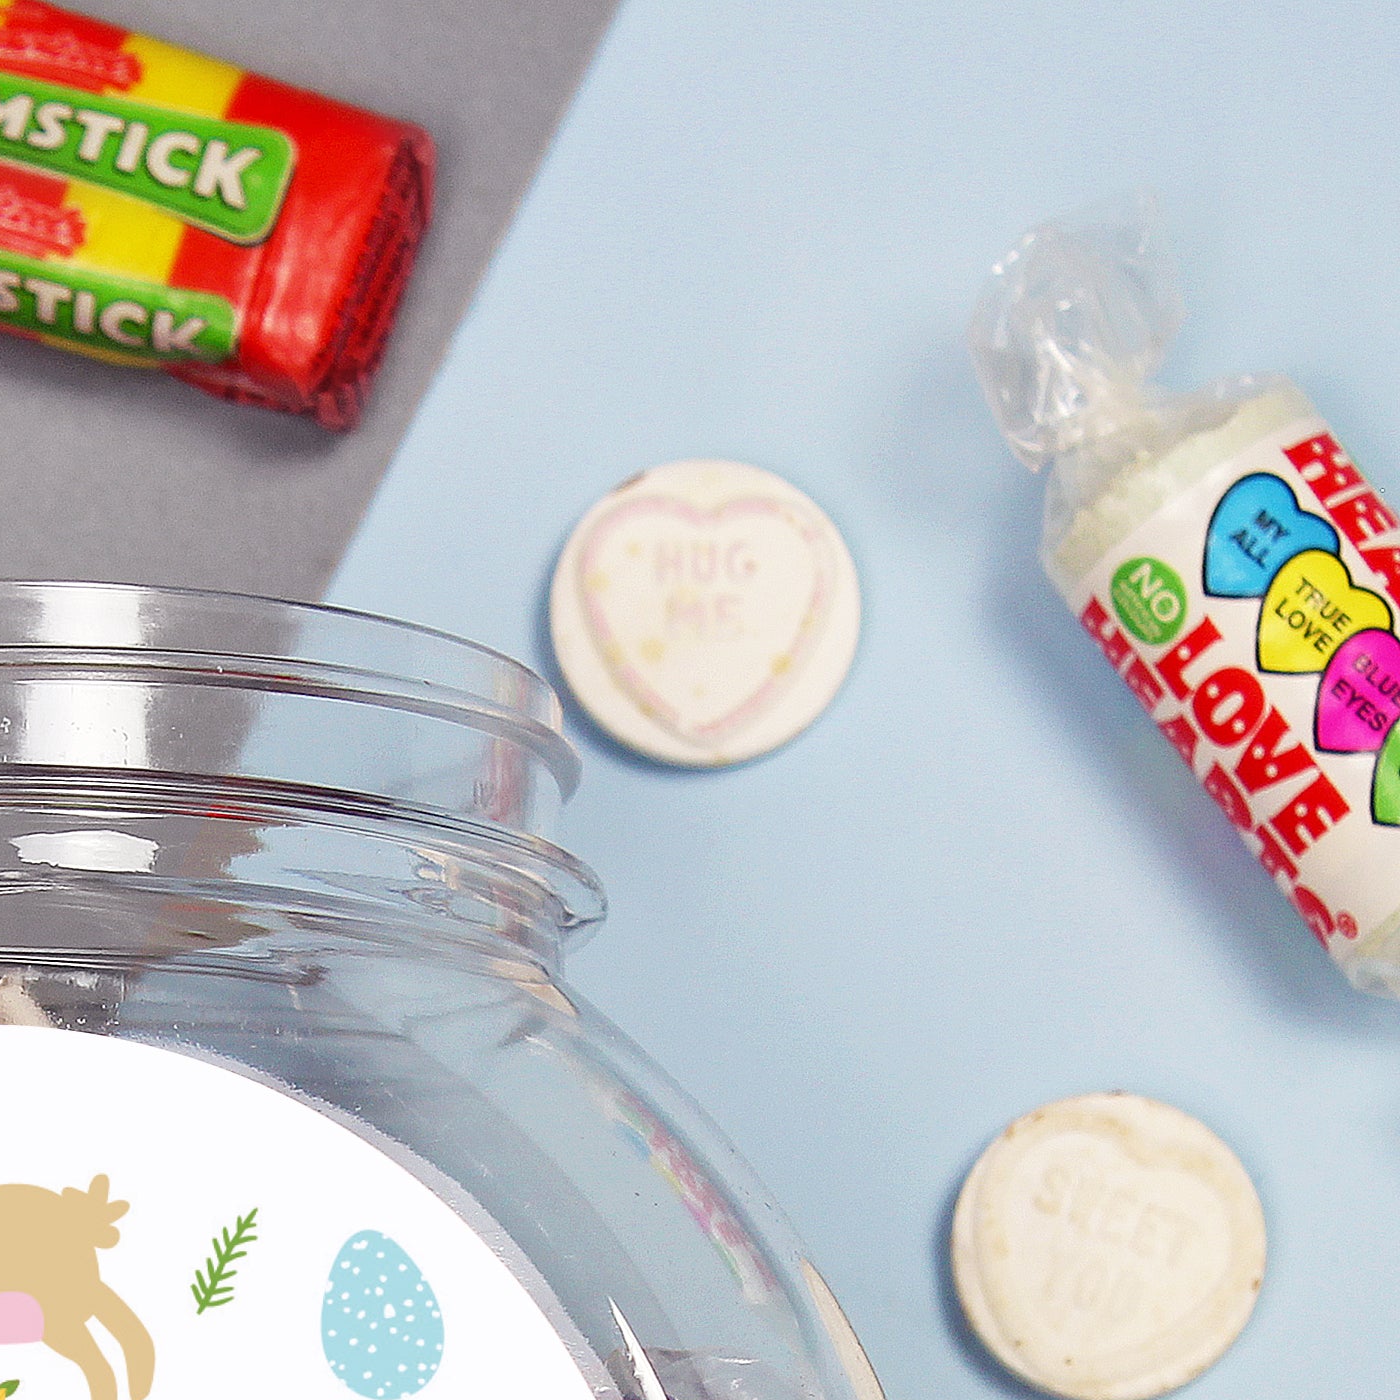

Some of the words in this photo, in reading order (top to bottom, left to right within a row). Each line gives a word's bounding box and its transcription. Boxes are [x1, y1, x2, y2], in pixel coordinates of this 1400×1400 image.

[1228, 526, 1271, 571] ALL
[1255, 508, 1287, 544] MY
[1128, 561, 1182, 625] NO
[1295, 576, 1352, 632] TRUE
[1274, 597, 1334, 654] LOVE
[1330, 678, 1388, 733] EYES
[1154, 615, 1351, 858] LOVE
